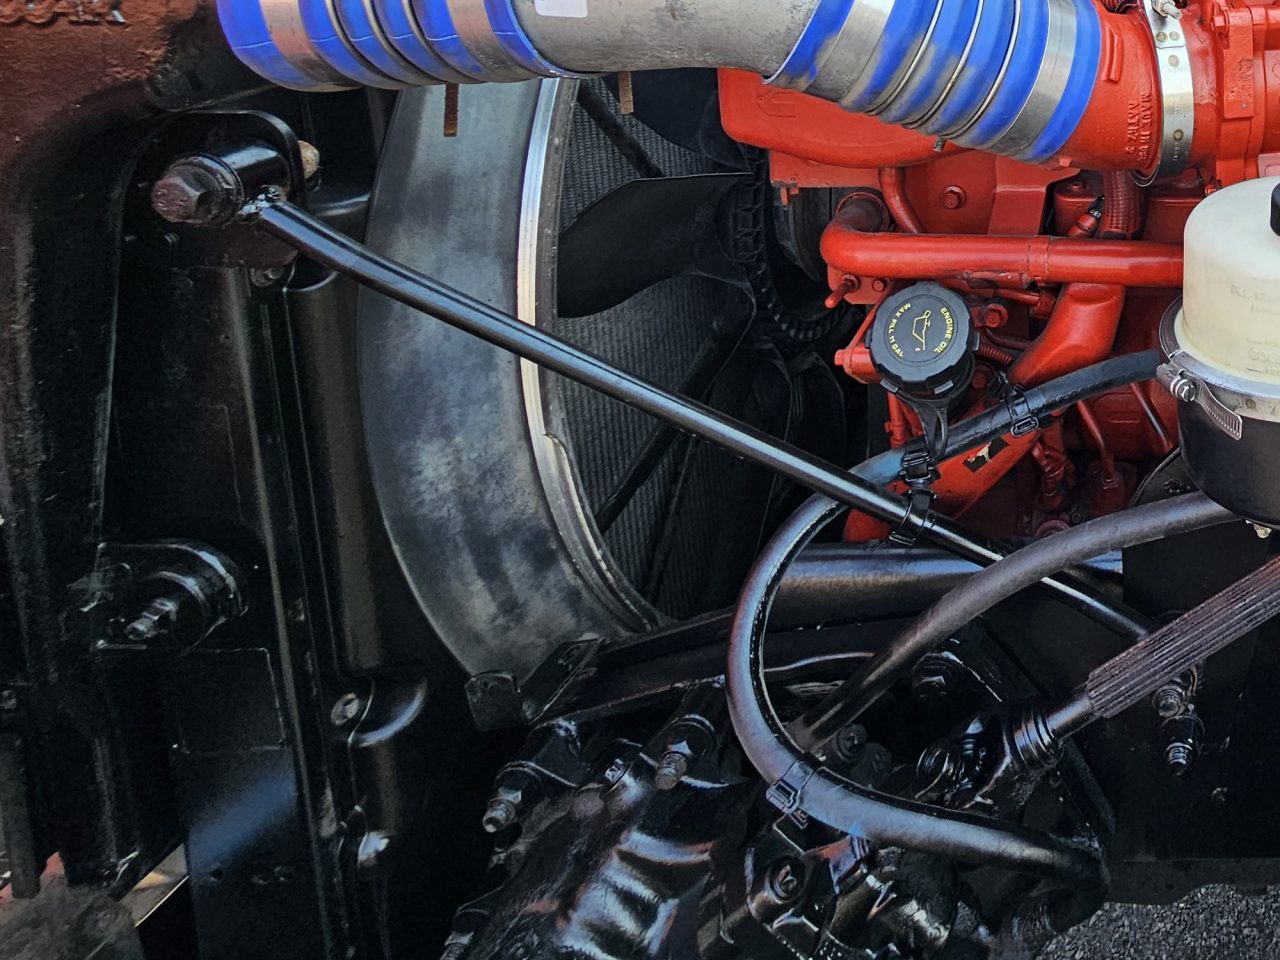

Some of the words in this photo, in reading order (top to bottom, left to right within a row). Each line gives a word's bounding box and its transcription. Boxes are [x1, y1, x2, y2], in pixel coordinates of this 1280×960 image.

[894, 302, 912, 318] MAX
[888, 318, 898, 334] FILL
[940, 307, 955, 340] ENGINE
[891, 343, 904, 357] GAL
[933, 342, 947, 354] OIL
